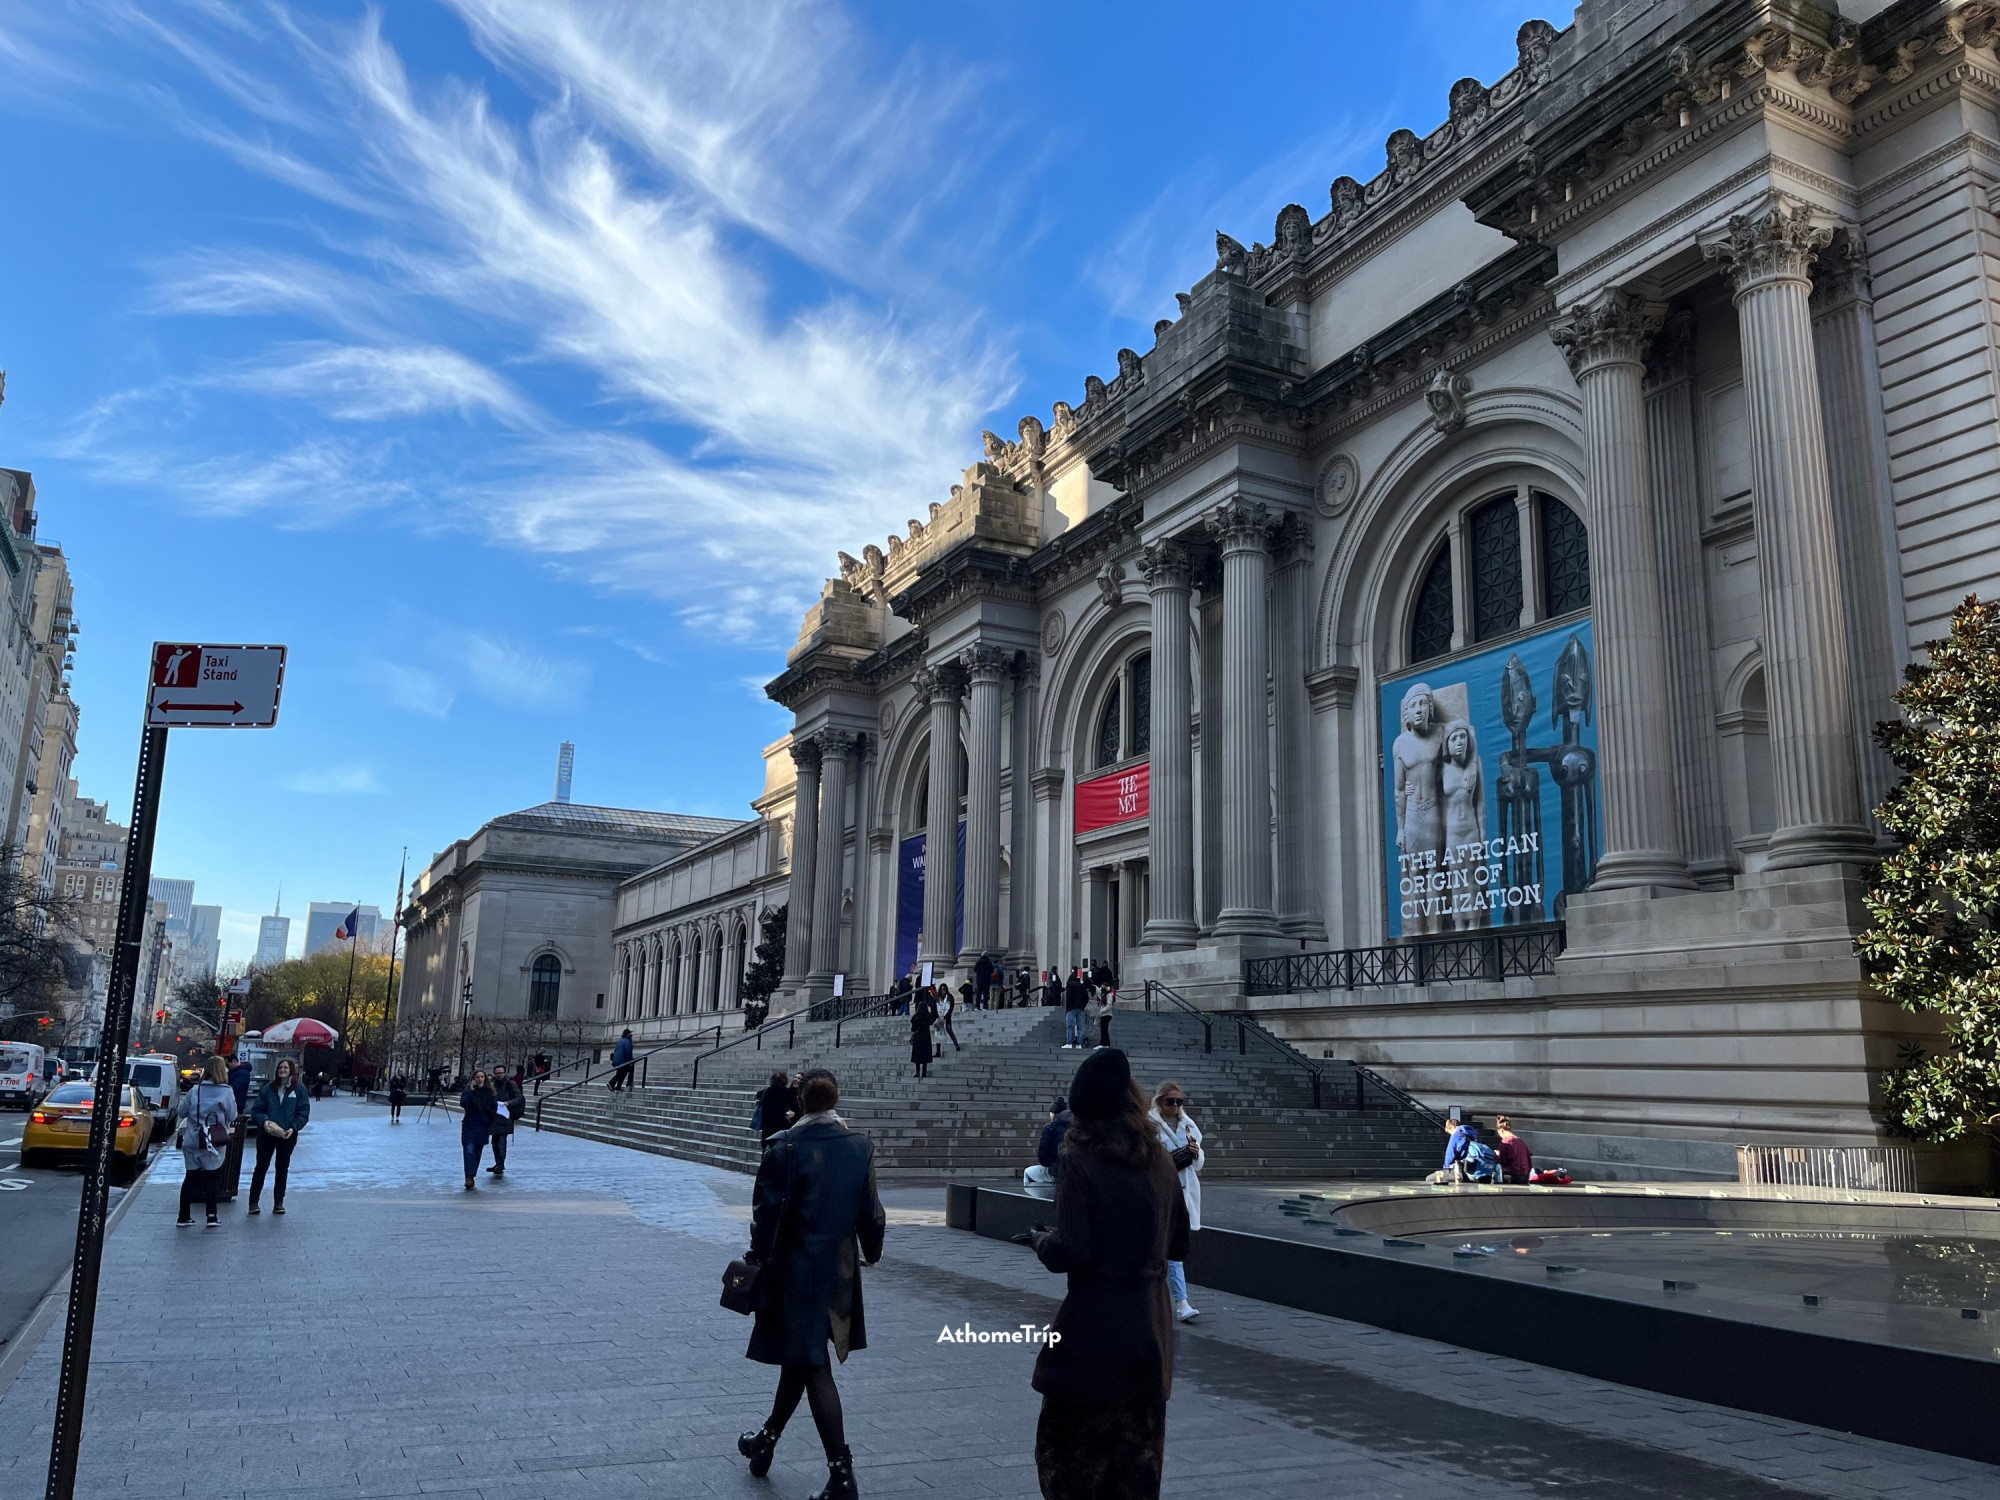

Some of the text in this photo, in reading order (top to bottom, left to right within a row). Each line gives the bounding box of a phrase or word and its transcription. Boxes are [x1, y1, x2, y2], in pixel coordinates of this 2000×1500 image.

[205, 655, 229, 667] Taxi
[203, 668, 238, 681] Stand
[1118, 774, 1138, 795] THE
[1118, 793, 1138, 815] MET
[1398, 832, 1539, 872] THE AFRICAN
[1399, 863, 1503, 895] ORIGIN OF
[1400, 884, 1542, 919] CIVILIZATION
